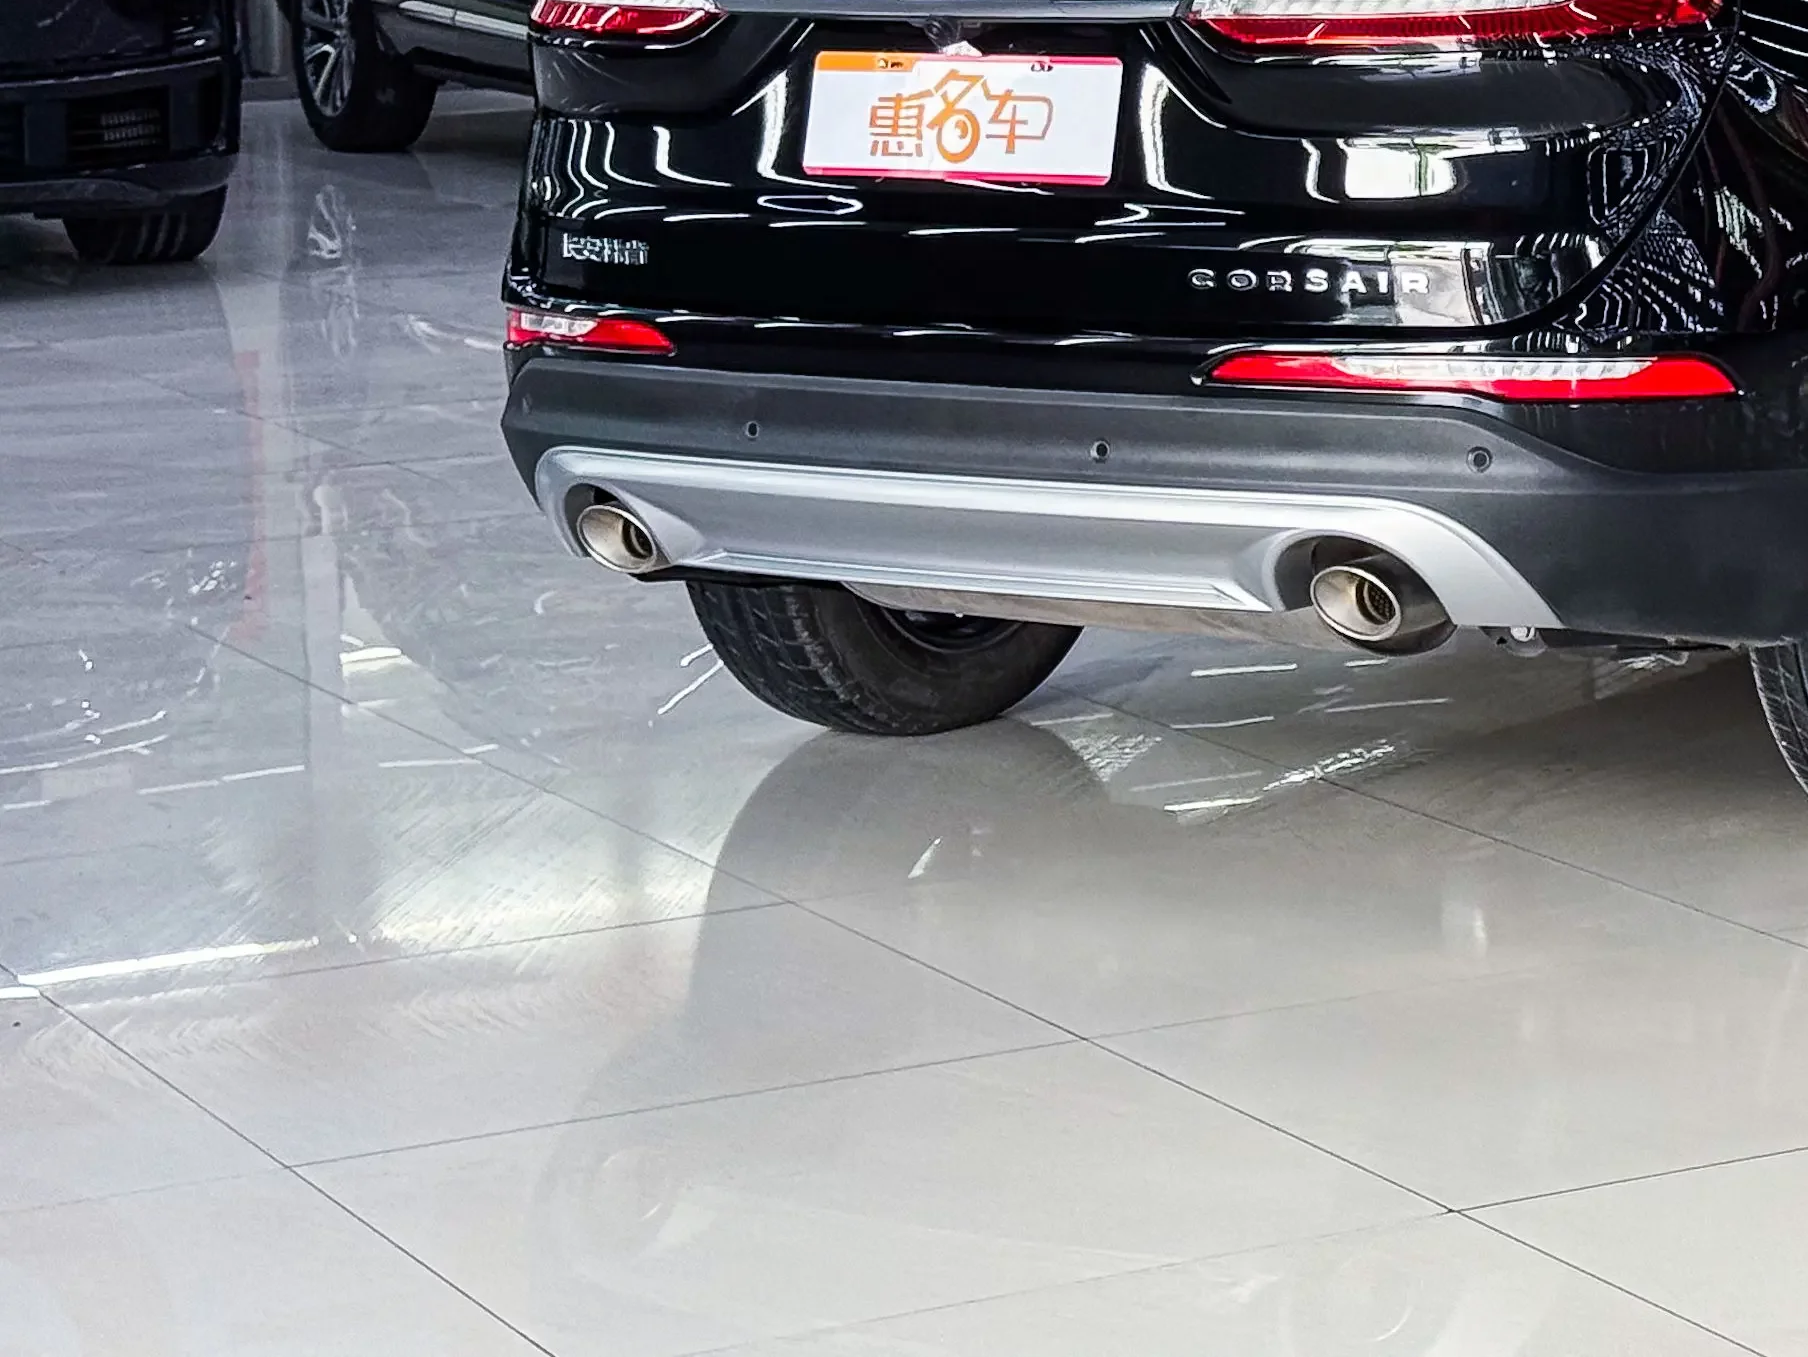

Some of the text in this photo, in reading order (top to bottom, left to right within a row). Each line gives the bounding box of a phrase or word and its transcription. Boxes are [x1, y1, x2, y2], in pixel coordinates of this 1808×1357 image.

[868, 69, 1054, 163] 惠名车
[1187, 267, 1430, 295] CORSAIR
